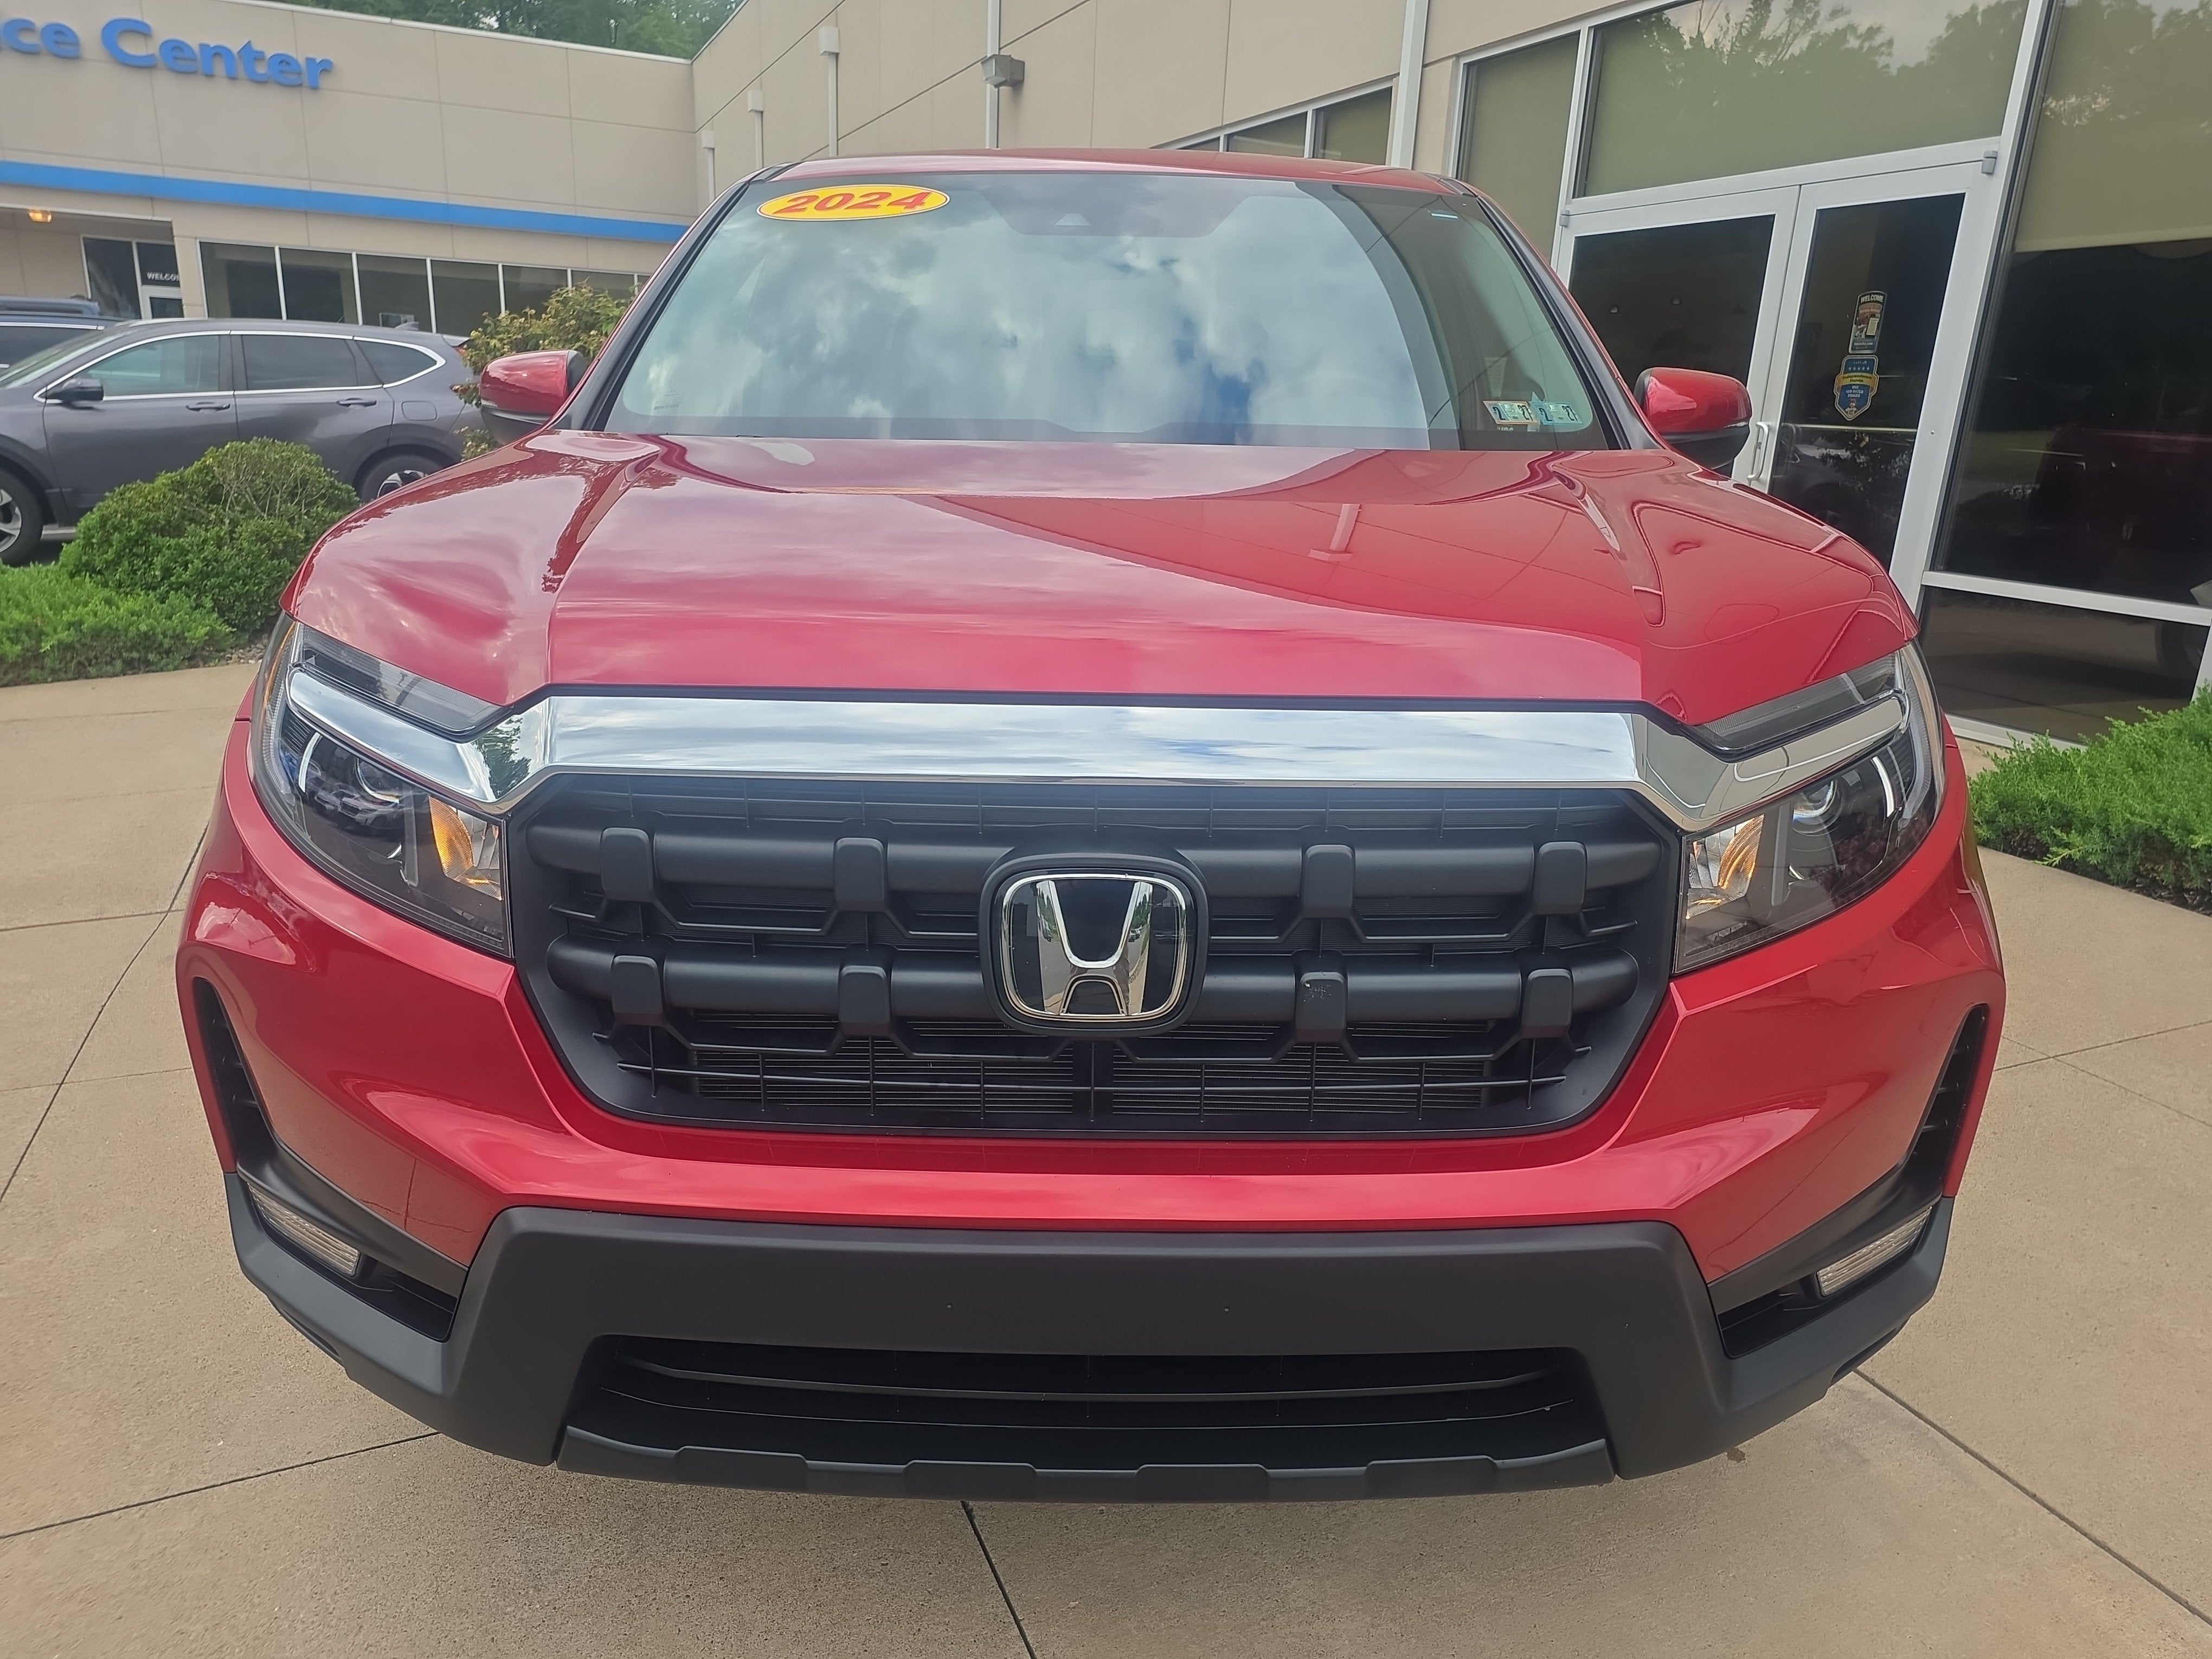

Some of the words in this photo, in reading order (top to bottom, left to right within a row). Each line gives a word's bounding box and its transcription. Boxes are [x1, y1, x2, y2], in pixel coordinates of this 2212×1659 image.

[100, 17, 335, 89] Center
[772, 191, 933, 215] 2024
[1861, 294, 1884, 303] WELCOME
